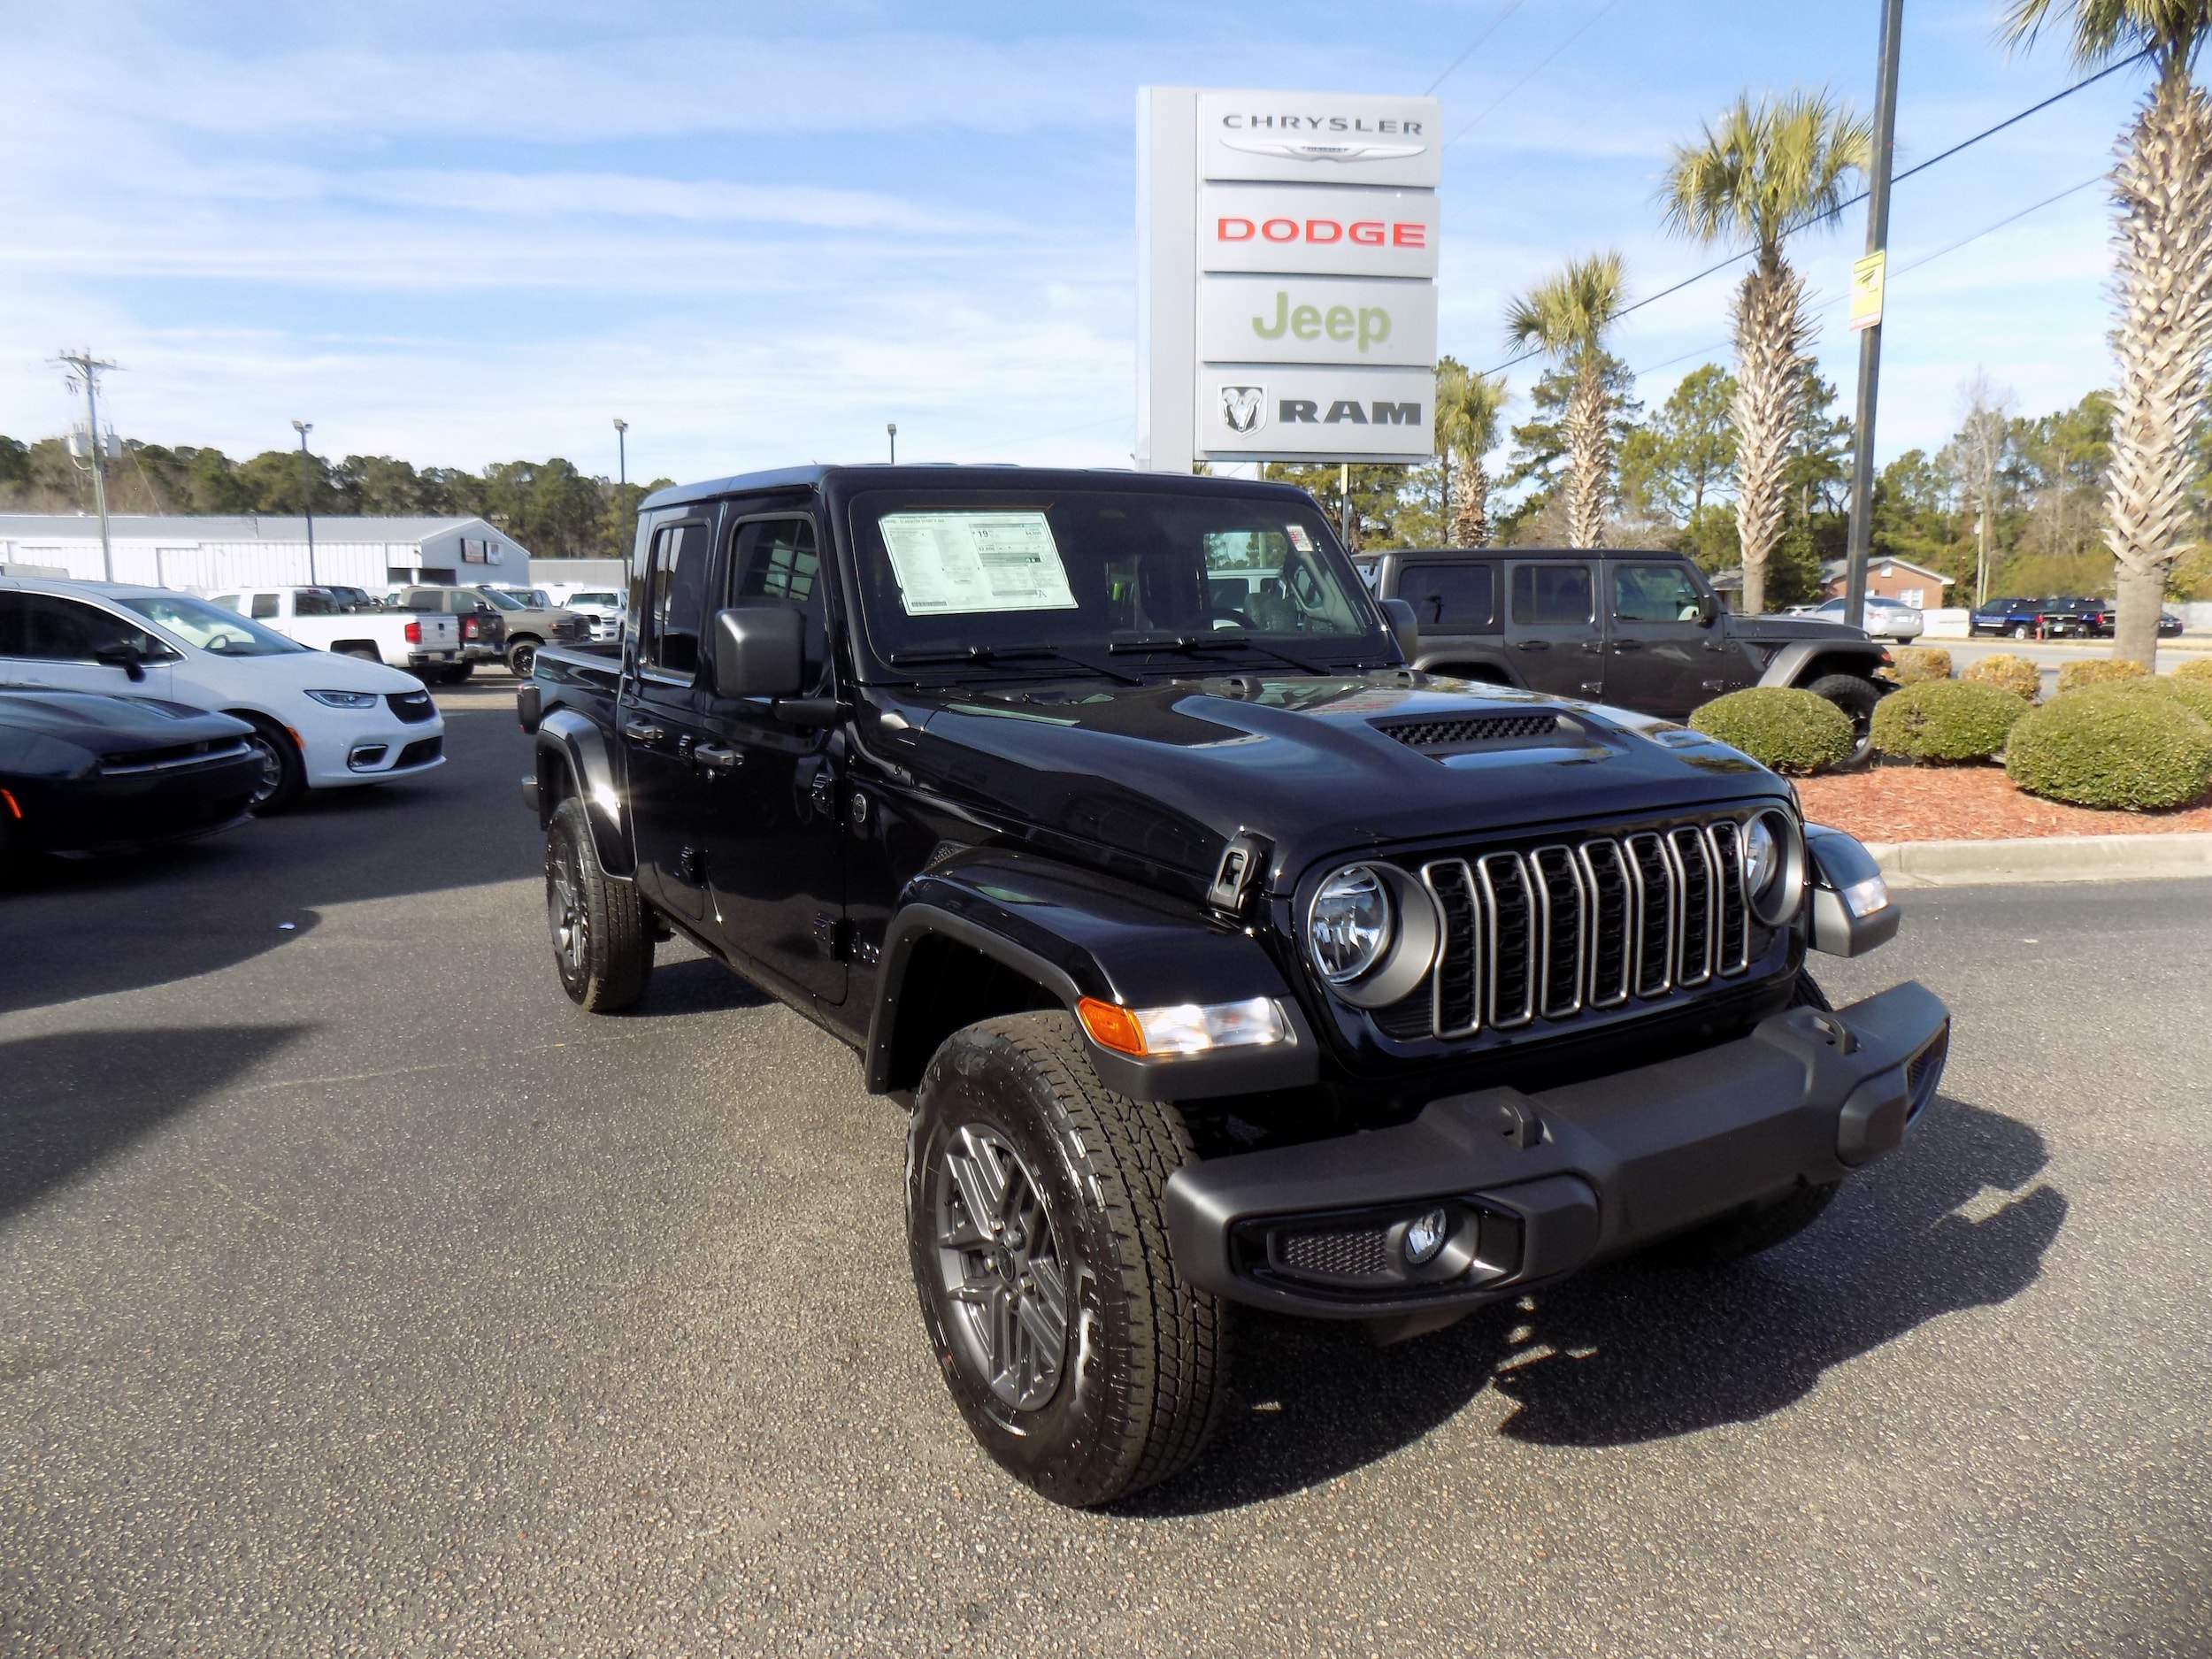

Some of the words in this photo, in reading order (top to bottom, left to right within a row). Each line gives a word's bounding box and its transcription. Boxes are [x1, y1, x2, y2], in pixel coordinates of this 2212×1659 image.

[1222, 114, 1424, 135] CHRYSLER
[1217, 218, 1425, 248] DODGE
[1252, 291, 1391, 352] Jeep
[1279, 399, 1422, 426] RAM
